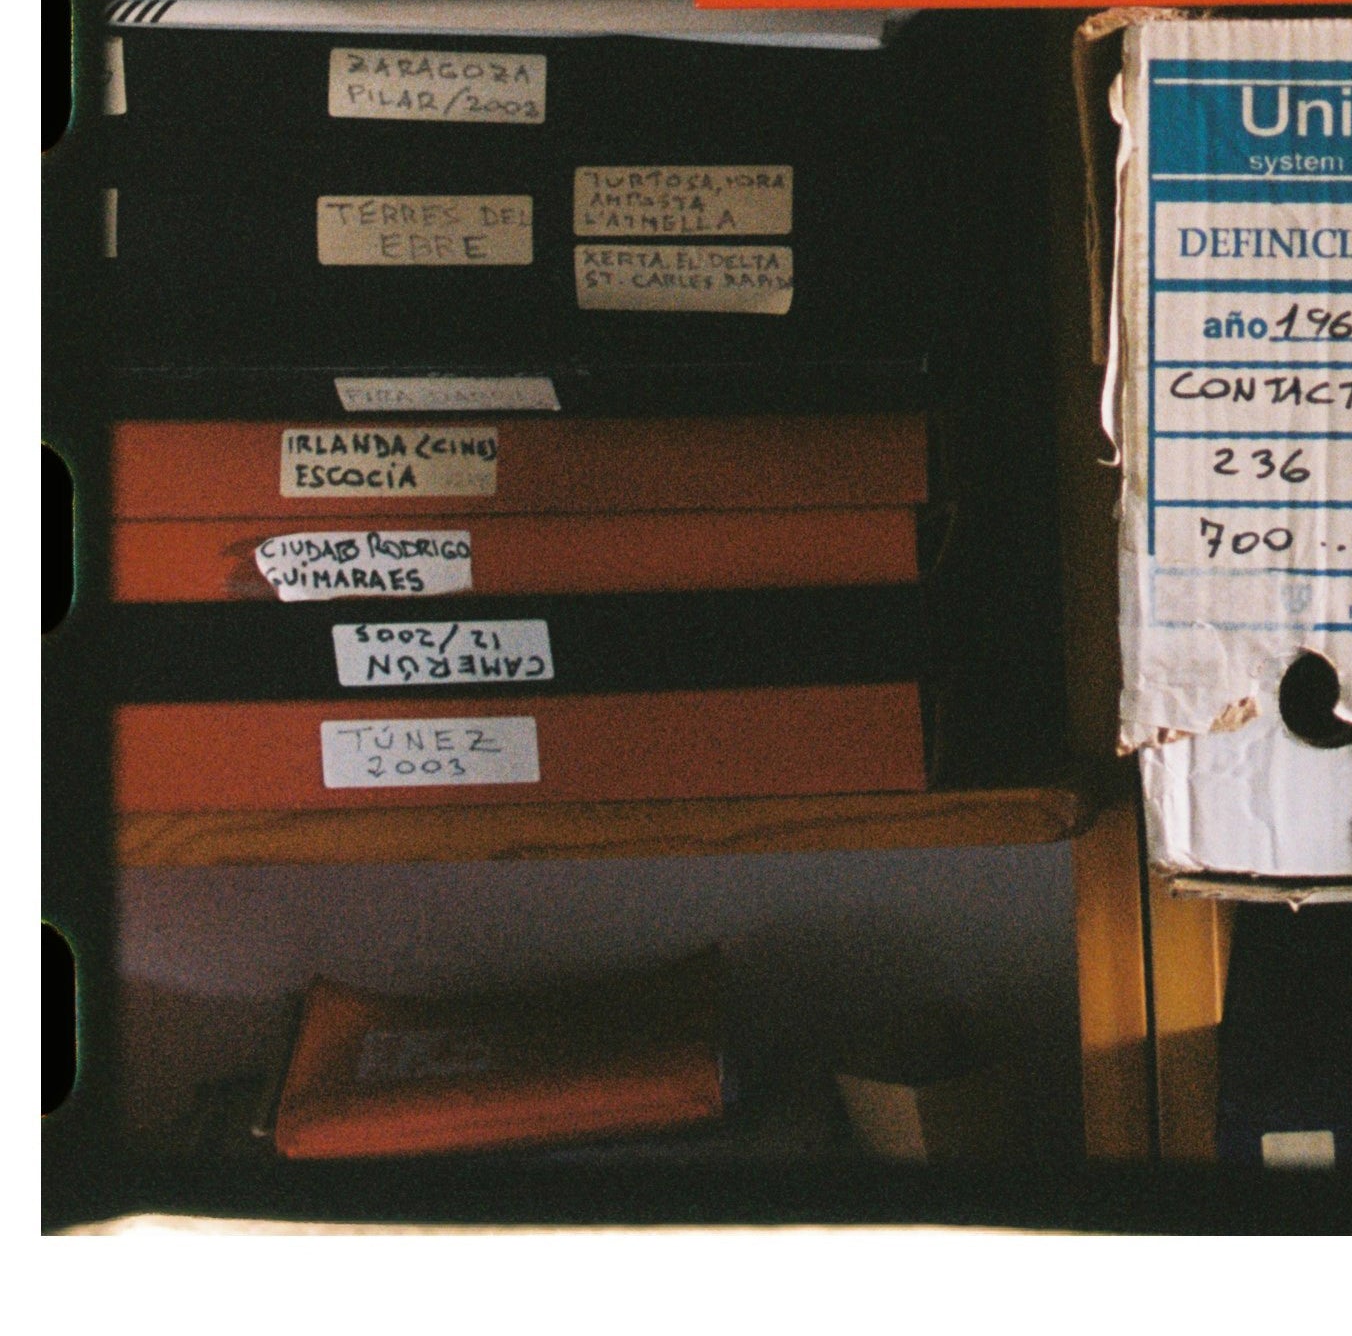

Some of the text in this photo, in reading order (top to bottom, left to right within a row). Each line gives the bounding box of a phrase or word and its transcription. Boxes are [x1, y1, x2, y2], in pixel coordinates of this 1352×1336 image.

[347, 54, 531, 84] ZARAGOZA
[1248, 154, 1345, 176] system
[480, 205, 533, 228] DEL
[380, 232, 488, 260] EBRE
[1203, 311, 1268, 339] año
[287, 434, 407, 459] IRLANDA
[1213, 446, 1312, 484] 236
[367, 531, 472, 561] RODRIGO
[1200, 517, 1294, 558] 700
[366, 653, 546, 682] CAMERÚN
[337, 724, 502, 754] TÚNEZ
[366, 755, 467, 779] 2003
